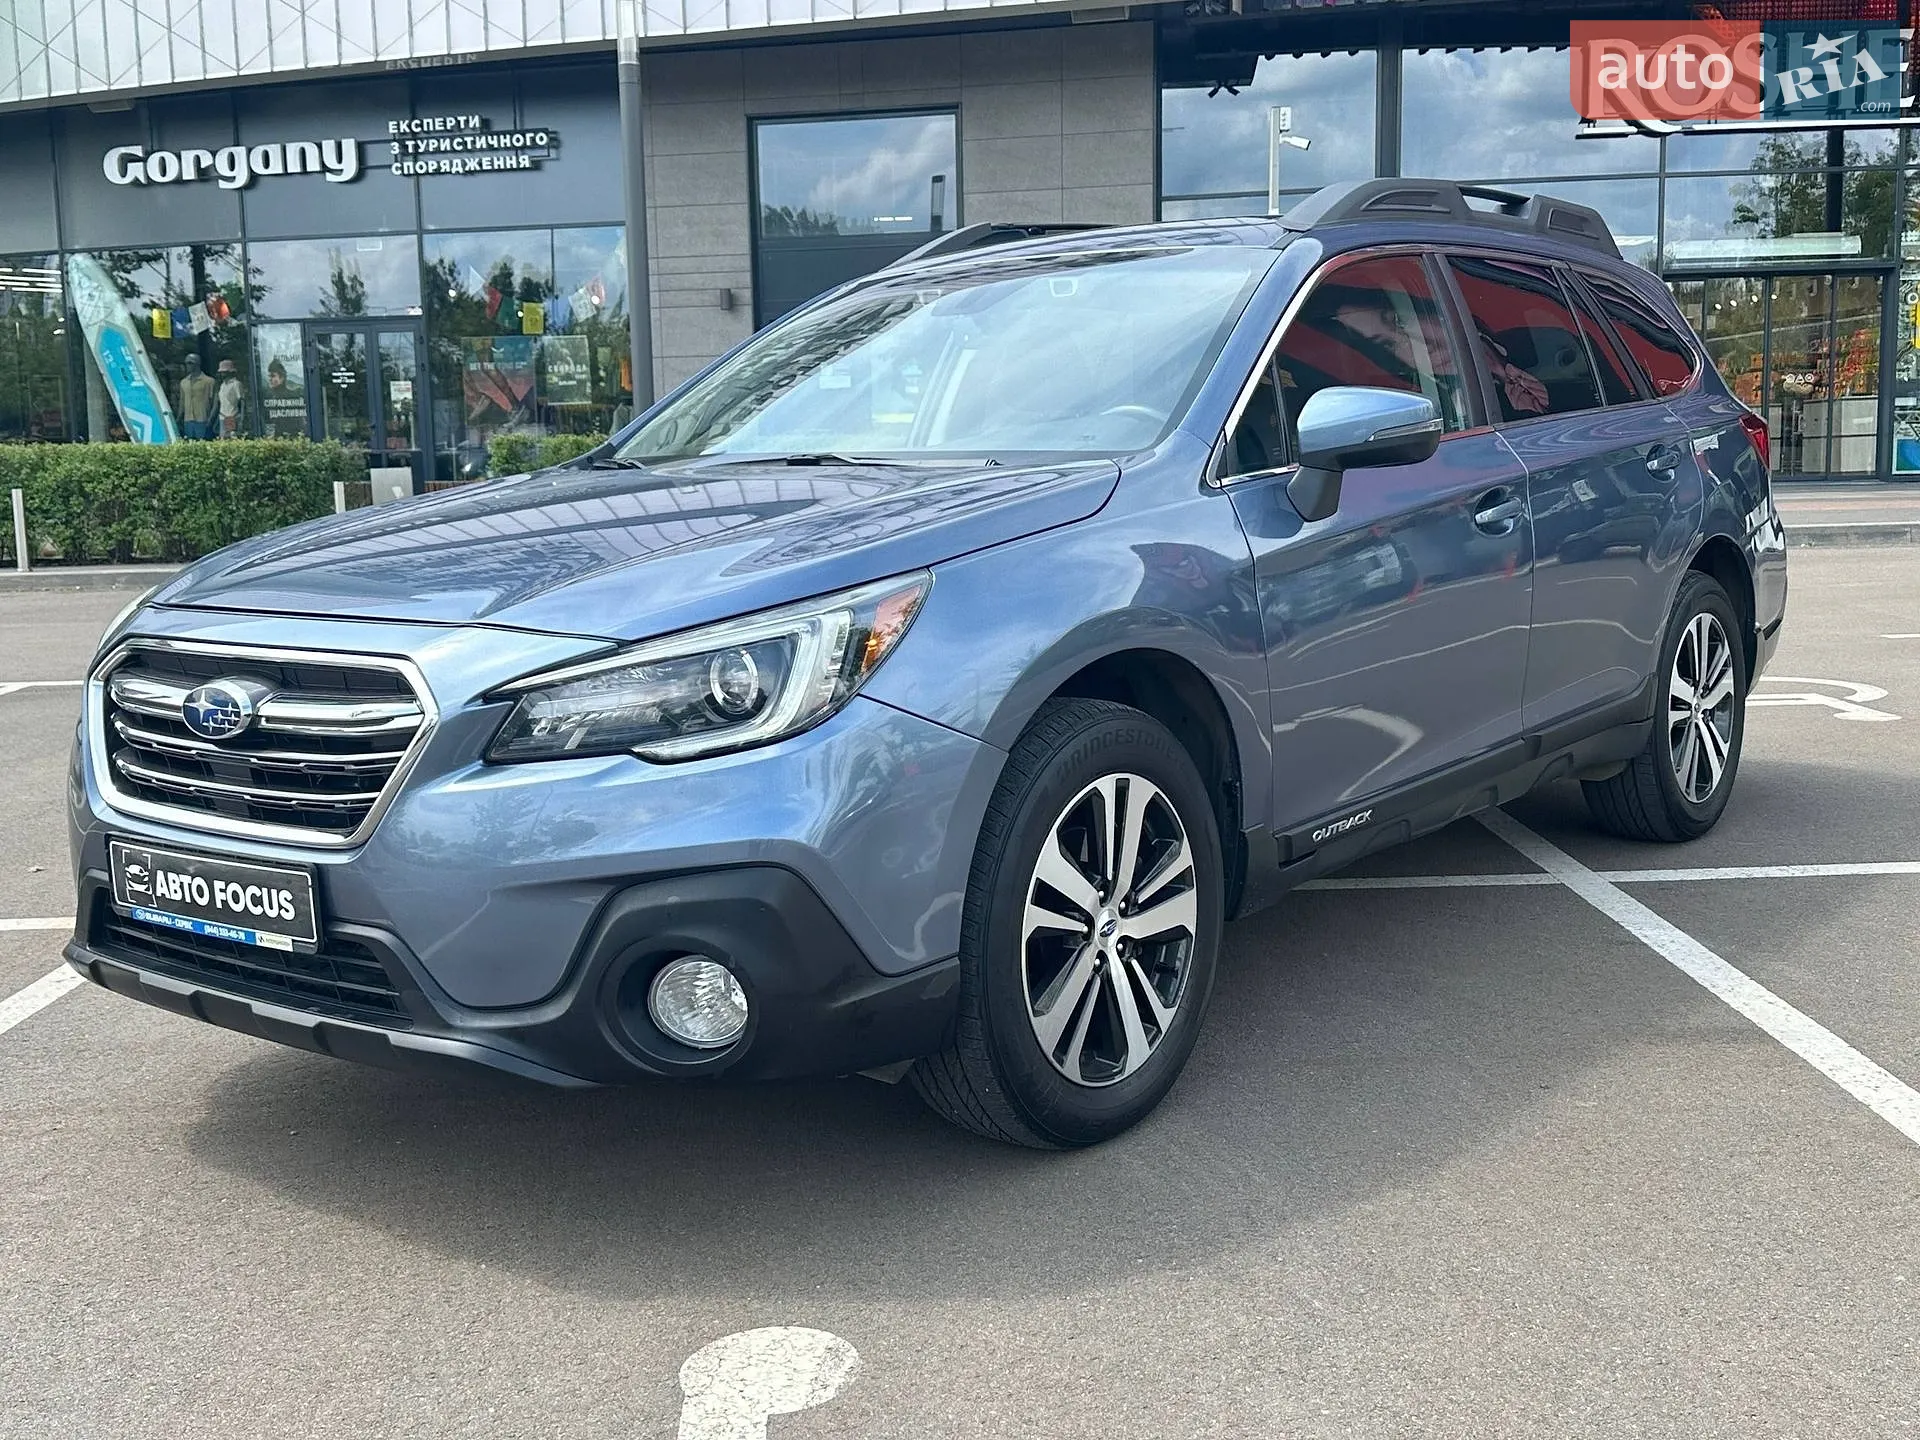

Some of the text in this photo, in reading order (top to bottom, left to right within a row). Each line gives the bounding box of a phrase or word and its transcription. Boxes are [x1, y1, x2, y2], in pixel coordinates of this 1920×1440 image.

[388, 115, 480, 133] ЕКСПЕРТИ
[390, 132, 549, 155] З ТУРИСТИЧНОГО
[103, 138, 359, 189] Gorgany
[391, 154, 531, 175] СПОРЯДЖЕННЯ
[1312, 809, 1373, 842] OUTBACK
[156, 869, 295, 920] АВТО FOCUS
